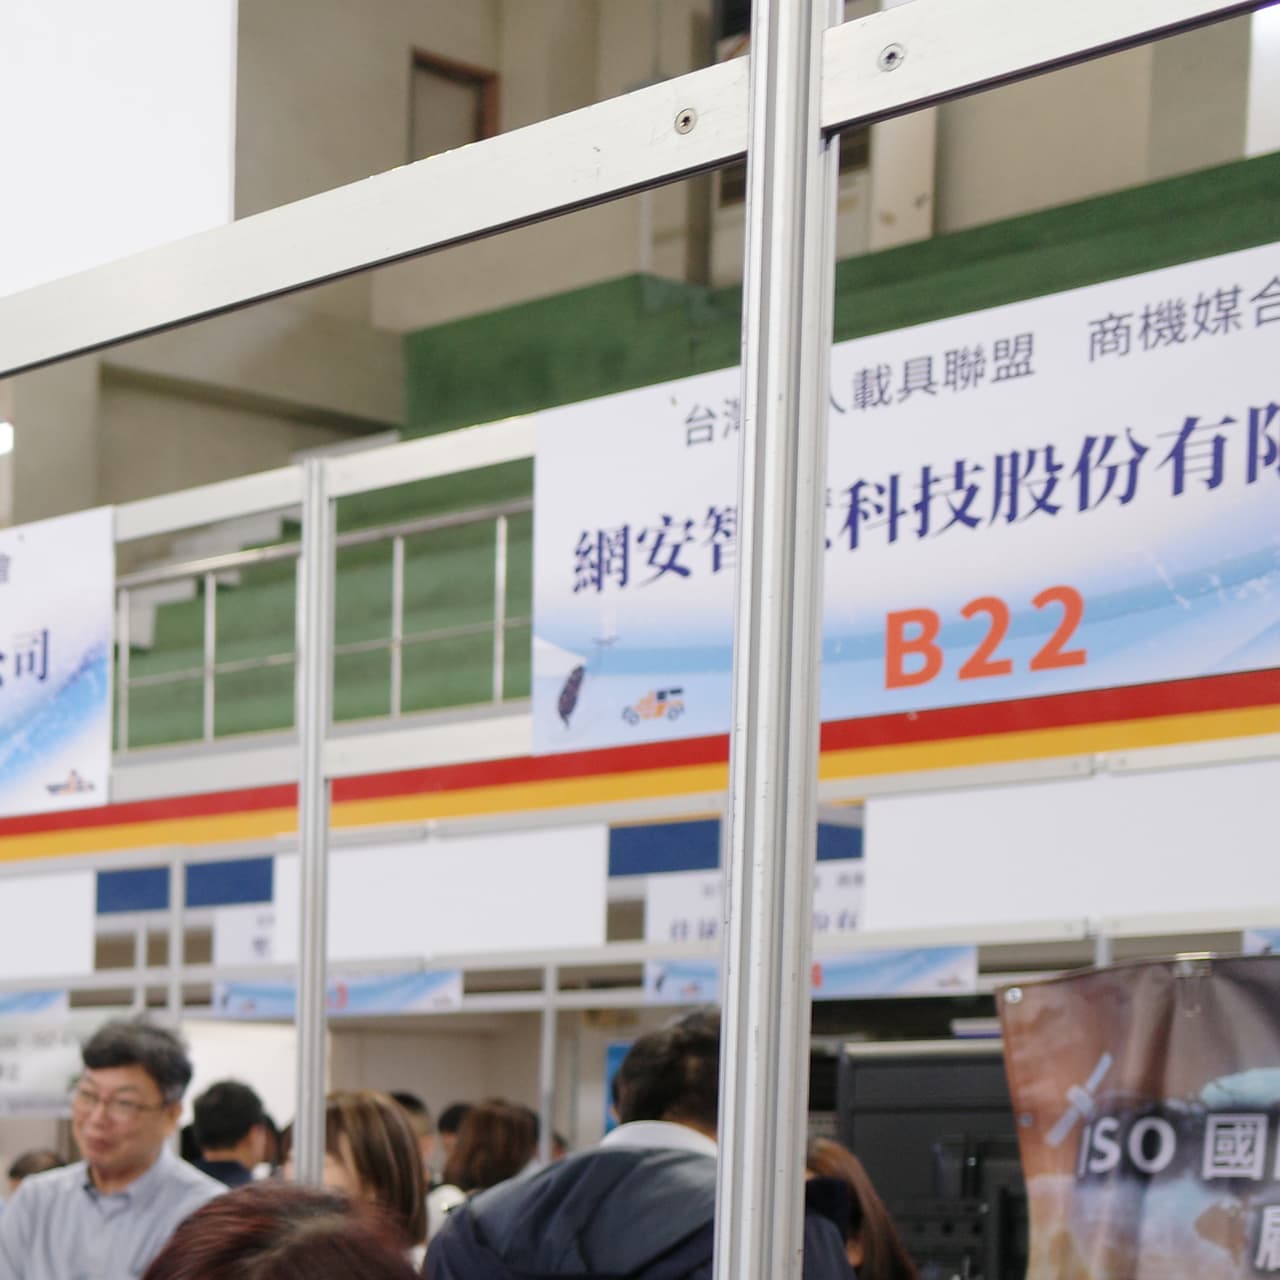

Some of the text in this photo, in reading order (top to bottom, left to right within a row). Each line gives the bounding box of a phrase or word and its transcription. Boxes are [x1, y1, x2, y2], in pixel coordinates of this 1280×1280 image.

[572, 402, 1280, 595] 網安智科技股份有
[883, 584, 1088, 691] B22
[1201, 1111, 1280, 1183] 國
